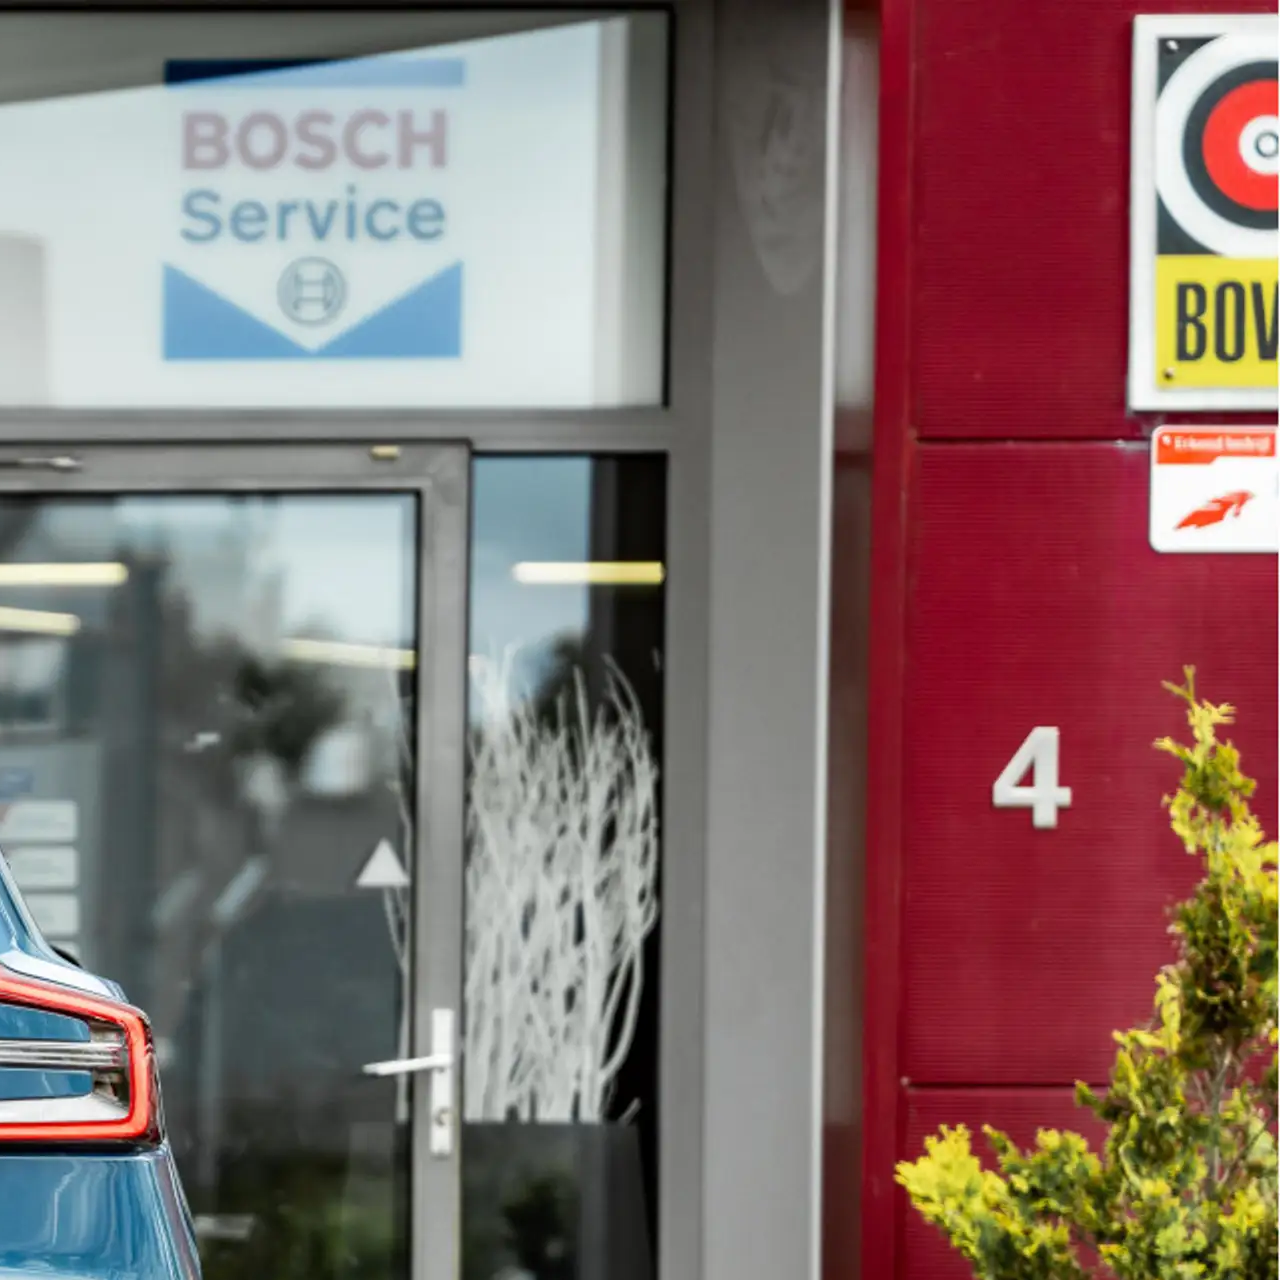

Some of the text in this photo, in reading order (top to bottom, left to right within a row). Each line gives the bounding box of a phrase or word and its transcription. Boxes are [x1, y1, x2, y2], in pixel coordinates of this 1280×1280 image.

[181, 109, 448, 170] BOSCH
[180, 184, 448, 244] Service
[992, 726, 1073, 829] 4
